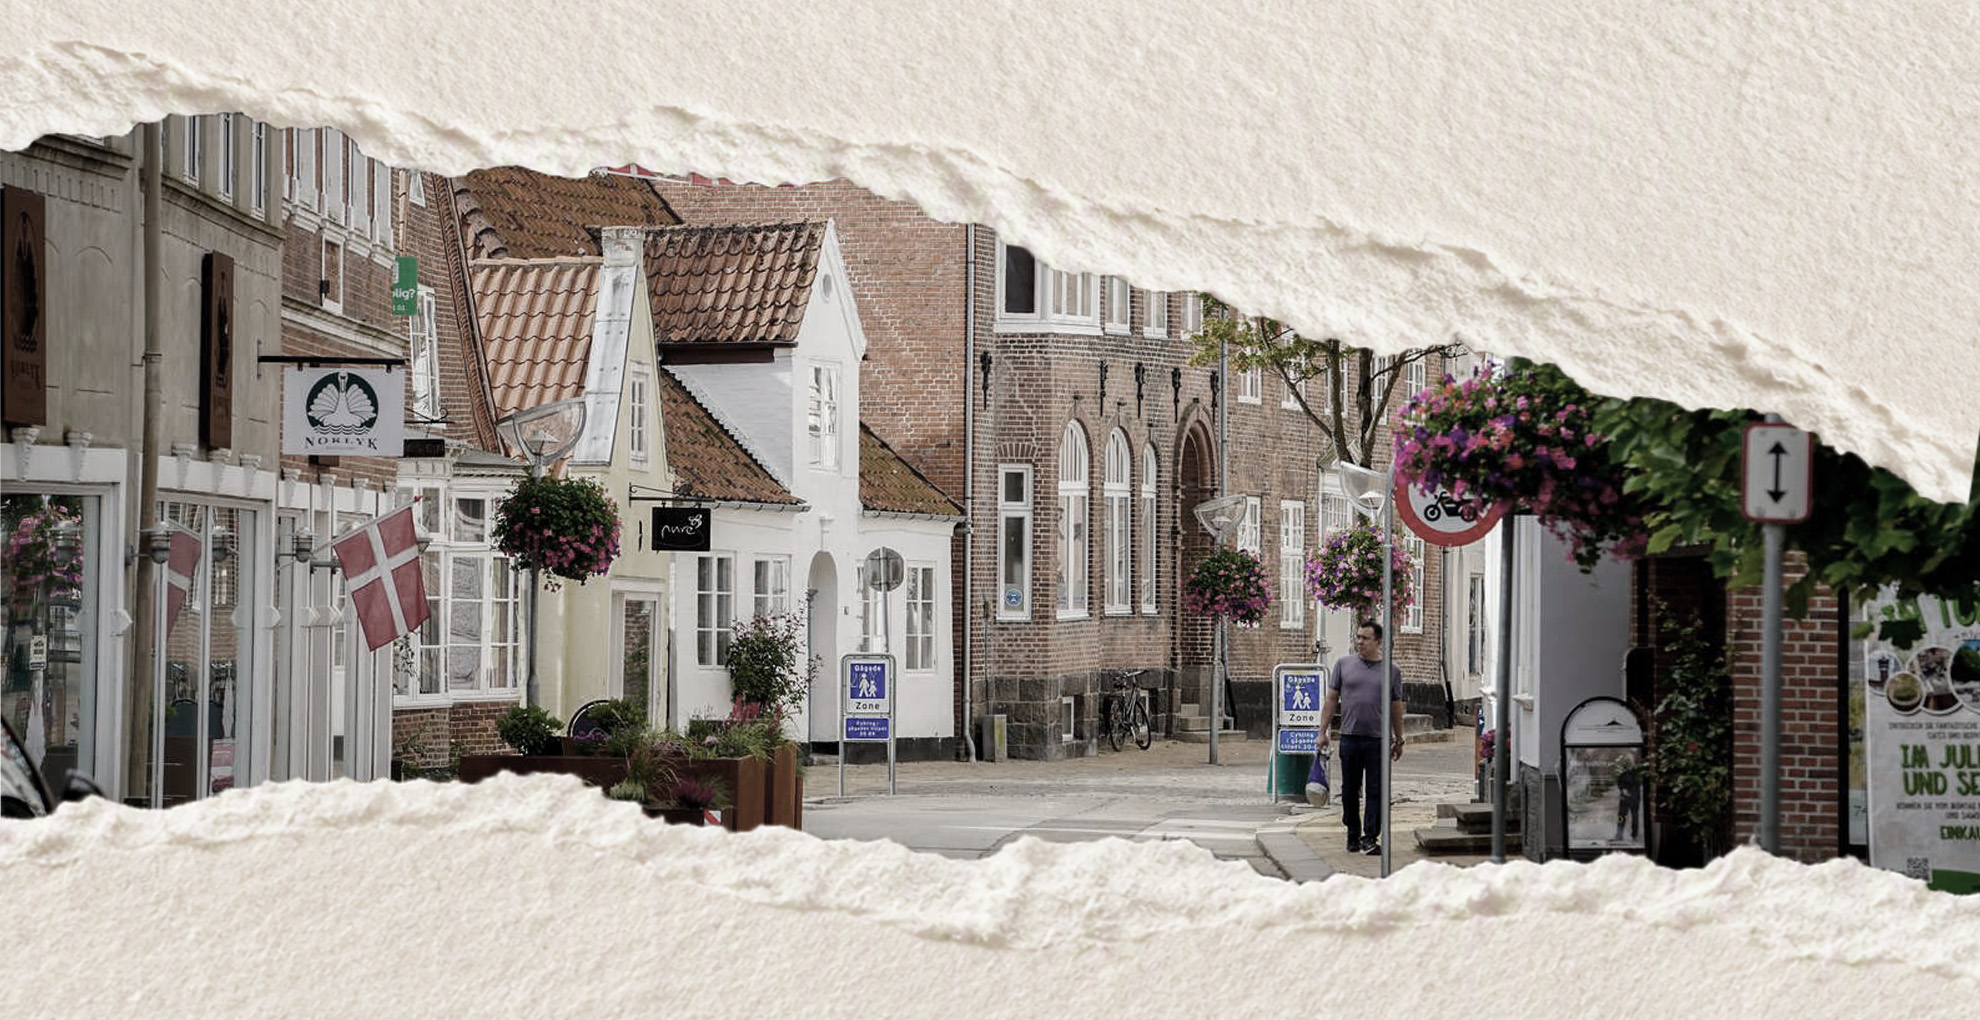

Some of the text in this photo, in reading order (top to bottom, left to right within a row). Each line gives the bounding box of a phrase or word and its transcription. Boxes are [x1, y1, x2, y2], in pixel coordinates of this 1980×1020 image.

[304, 436, 378, 450] NORLYK
[856, 702, 880, 710] Zone
[1289, 713, 1315, 722] Zone
[1900, 744, 1930, 769] IM
[1903, 771, 1947, 796] UND
